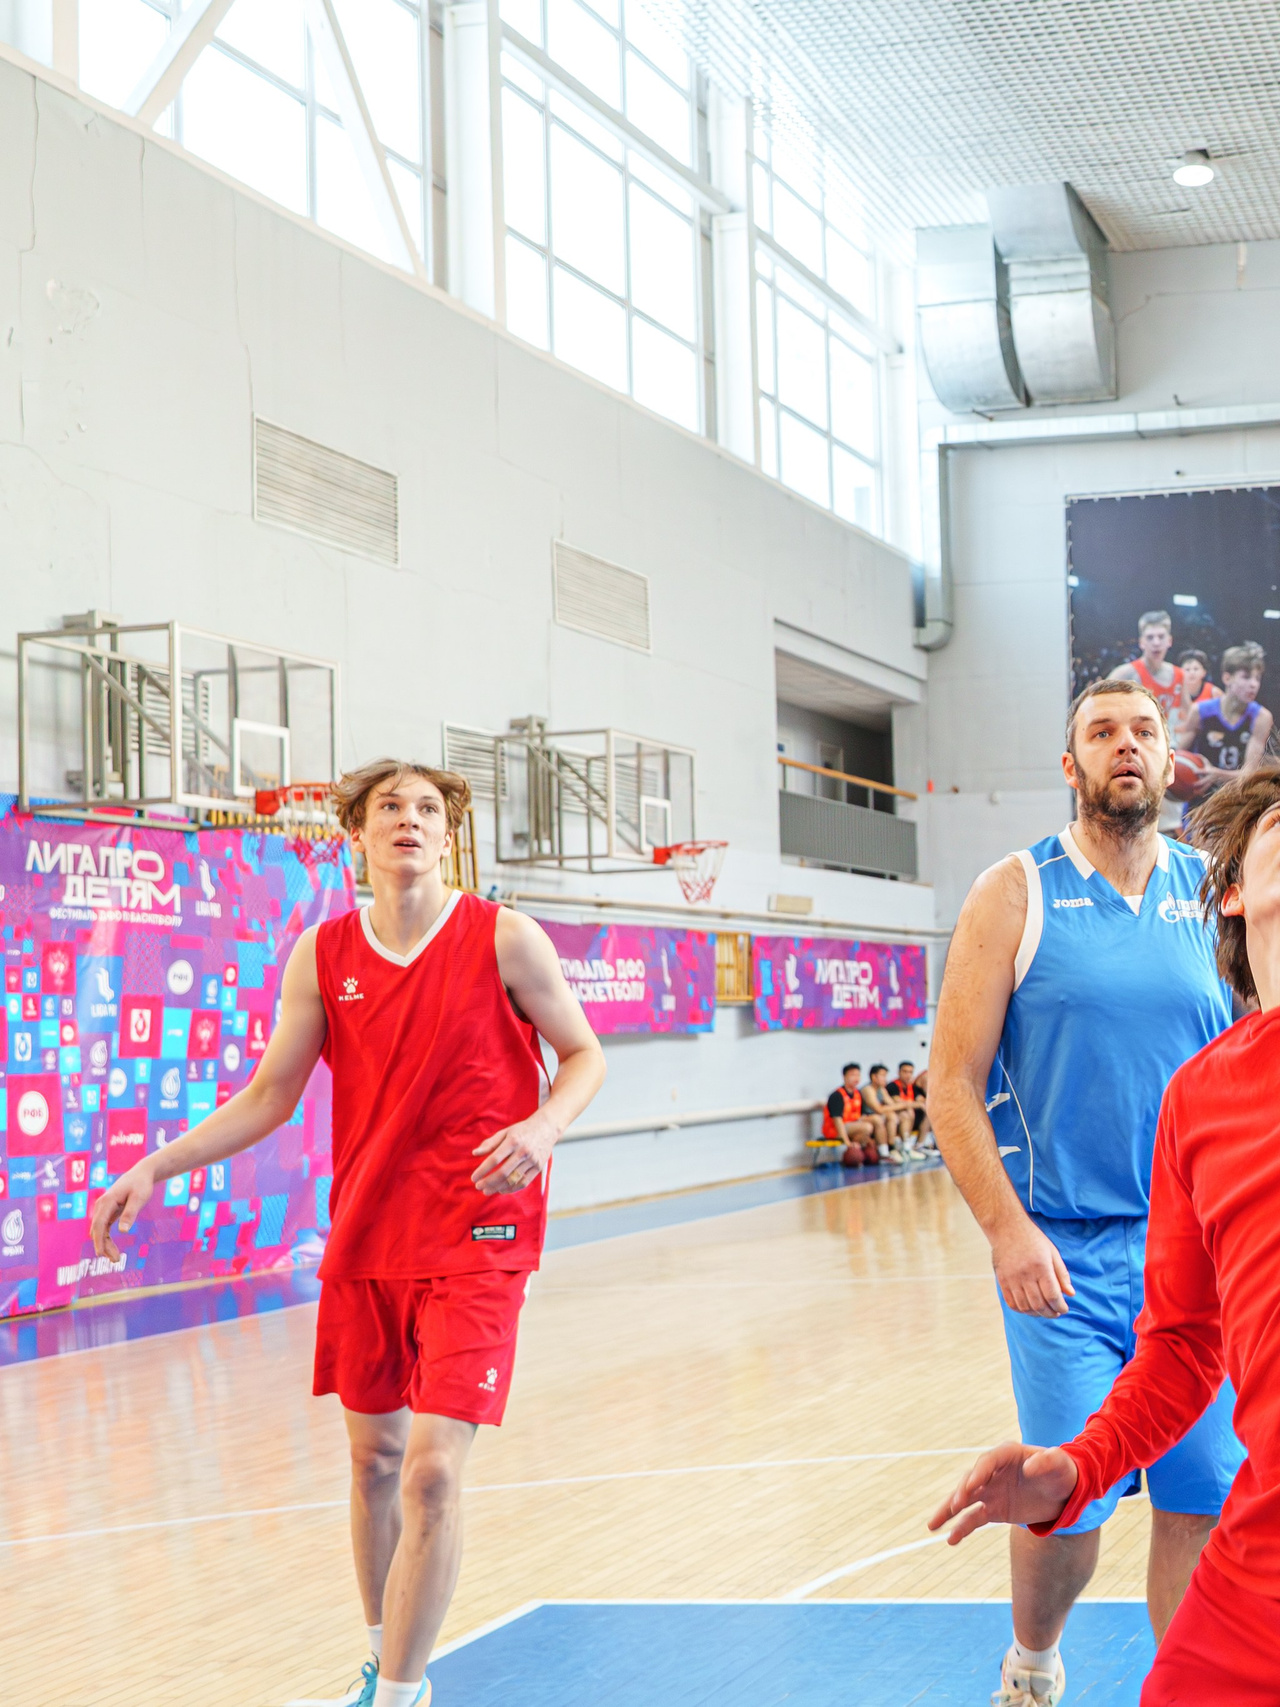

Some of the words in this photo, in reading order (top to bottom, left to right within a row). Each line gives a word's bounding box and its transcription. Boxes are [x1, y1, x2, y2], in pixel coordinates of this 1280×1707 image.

[99, 846, 165, 882] ПРО
[62, 874, 181, 914] ДЕТЯМ
[560, 958, 615, 980] ТИВАЛЬ
[338, 993, 364, 1001] KELME
[569, 980, 645, 1002] АСКЕТБОЛУ
